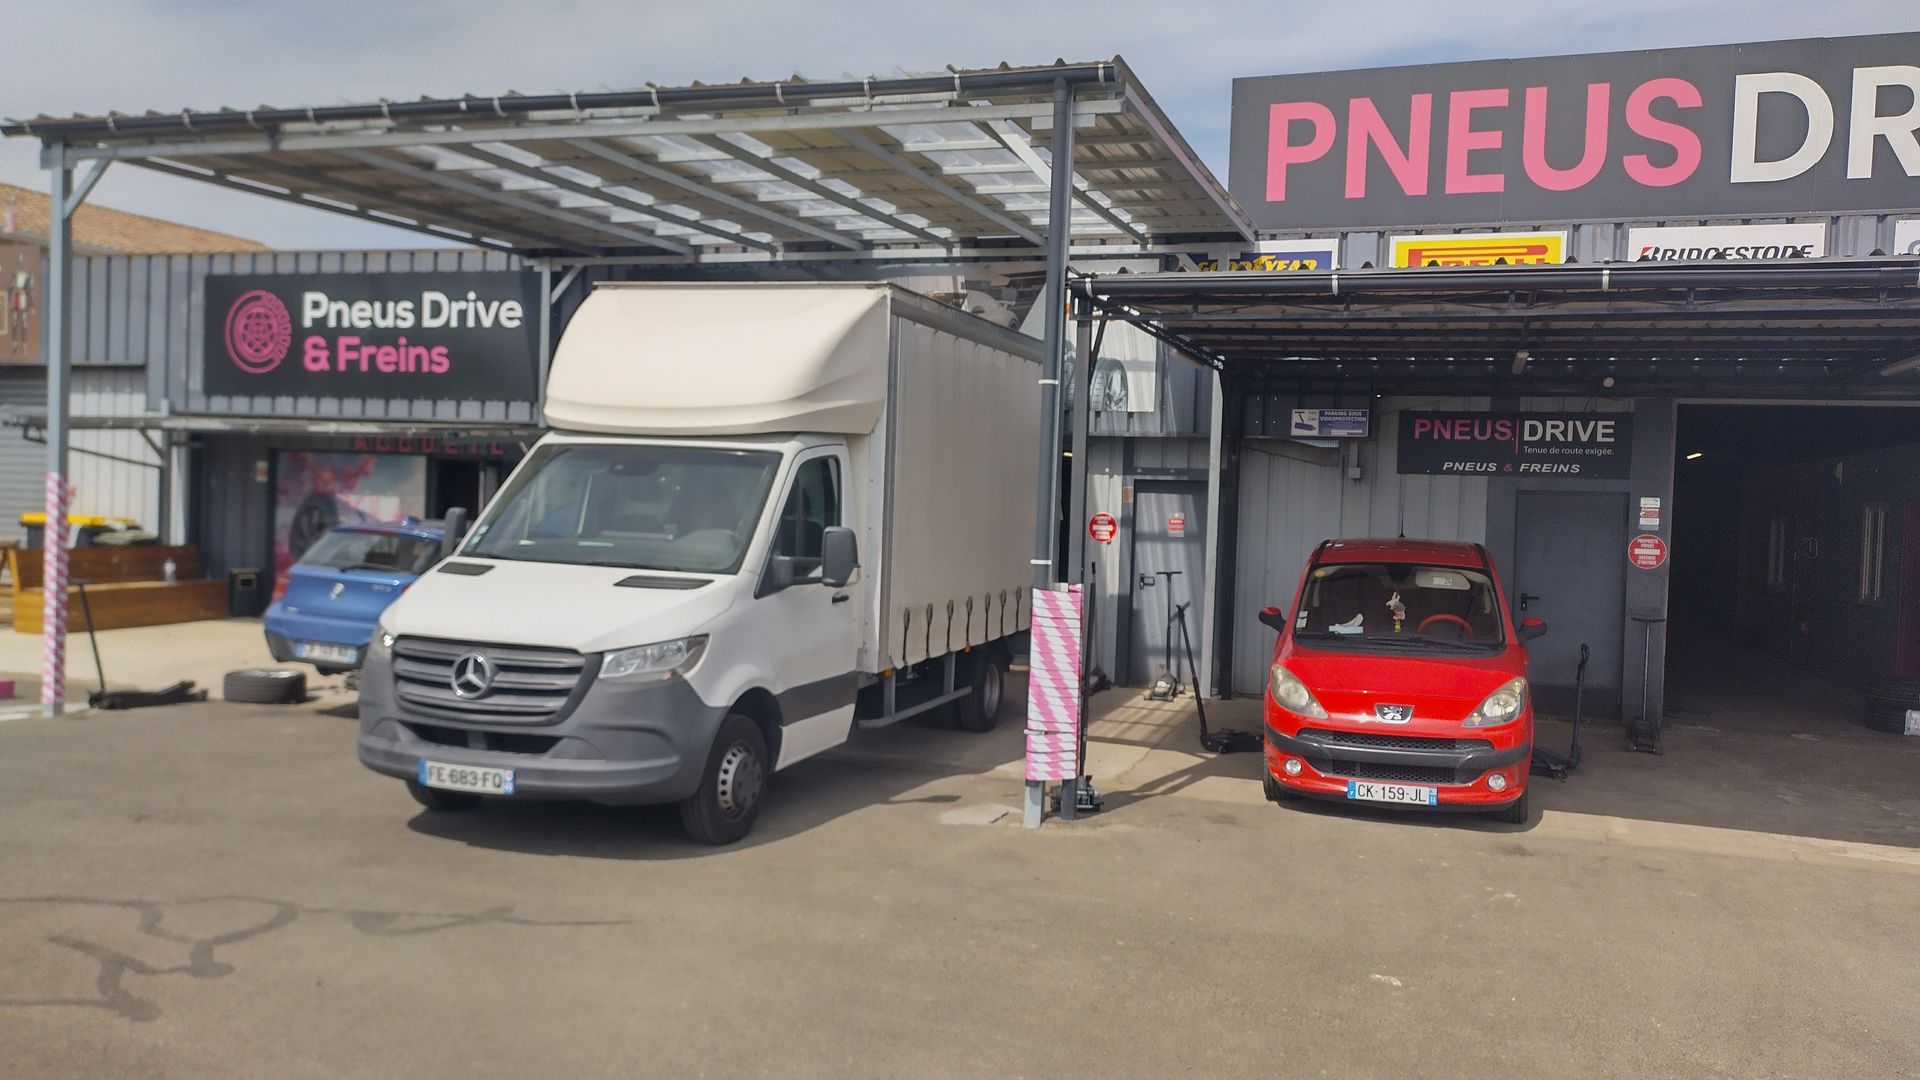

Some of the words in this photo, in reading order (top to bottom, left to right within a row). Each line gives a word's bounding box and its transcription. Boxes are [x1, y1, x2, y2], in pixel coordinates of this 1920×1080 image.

[1265, 78, 1703, 202] PNEUS
[302, 291, 415, 328] Pneus
[421, 290, 523, 328] Drive
[303, 335, 330, 372] &
[337, 336, 450, 373] Freins
[1414, 419, 1512, 440] PNEUS
[1523, 420, 1615, 442] DRIVE
[1523, 446, 1548, 454] Tenue
[1549, 446, 1560, 454] de
[1561, 447, 1583, 455] route
[1443, 461, 1497, 472] PNEUS
[1503, 463, 1513, 472] &
[1519, 463, 1581, 473] FREINS
